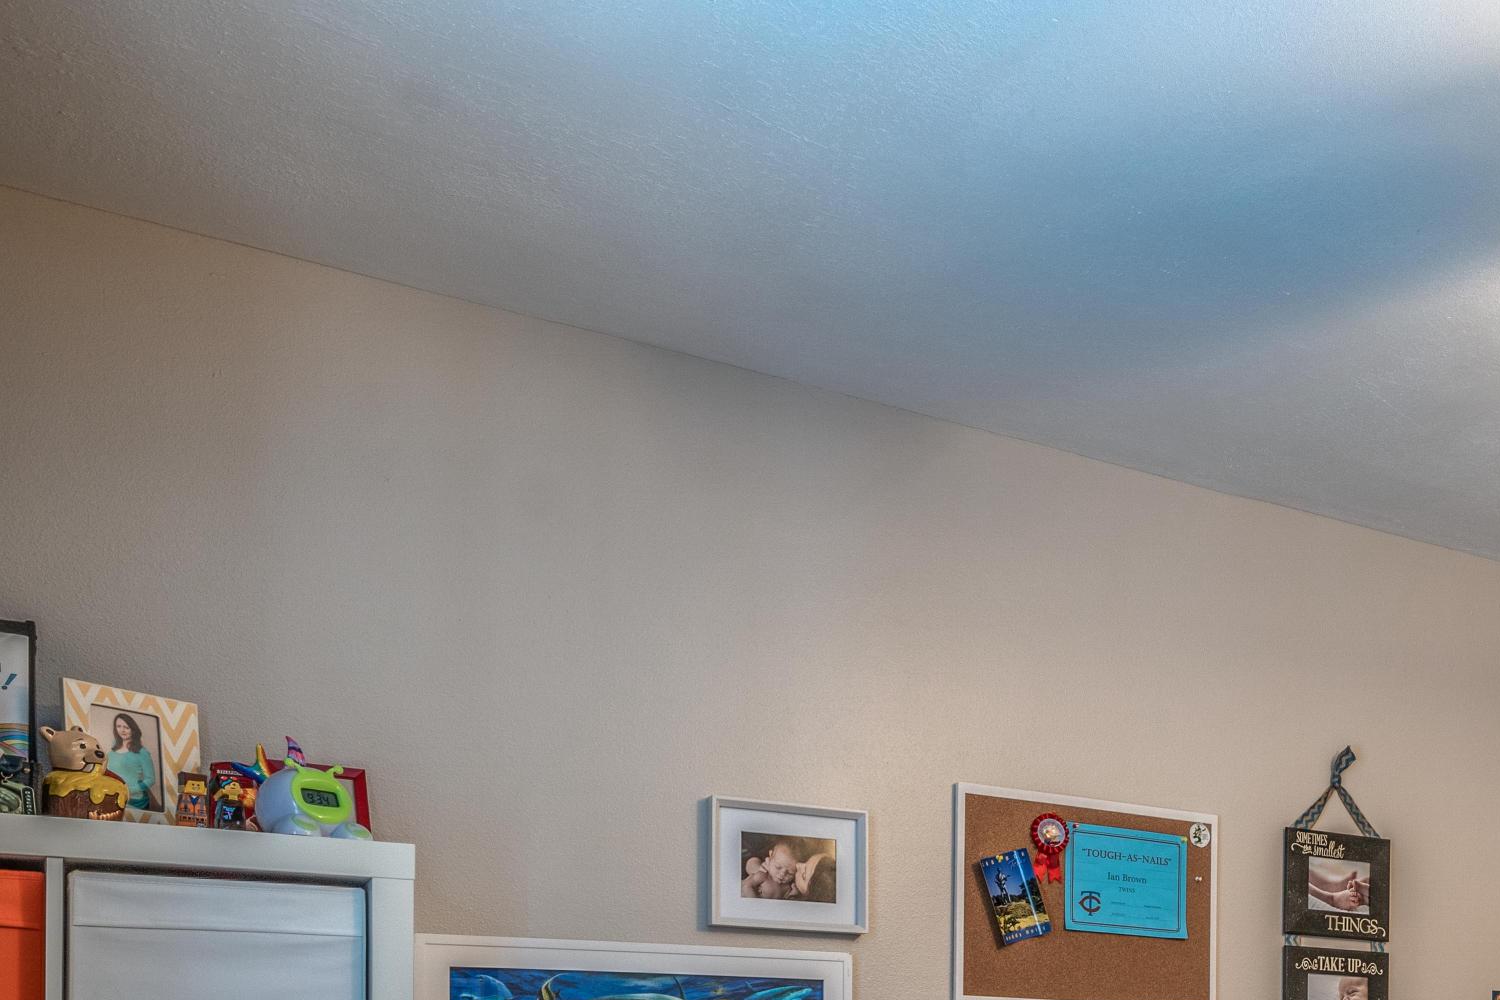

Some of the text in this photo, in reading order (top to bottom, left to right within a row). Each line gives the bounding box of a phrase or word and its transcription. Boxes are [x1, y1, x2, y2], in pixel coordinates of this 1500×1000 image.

[1296, 830, 1328, 846] SOMETIMES
[1312, 839, 1346, 859] smallest
[1107, 871, 1147, 884] Ian Brown
[1325, 914, 1384, 936] THINGS
[1317, 956, 1362, 973] TAKE UP
